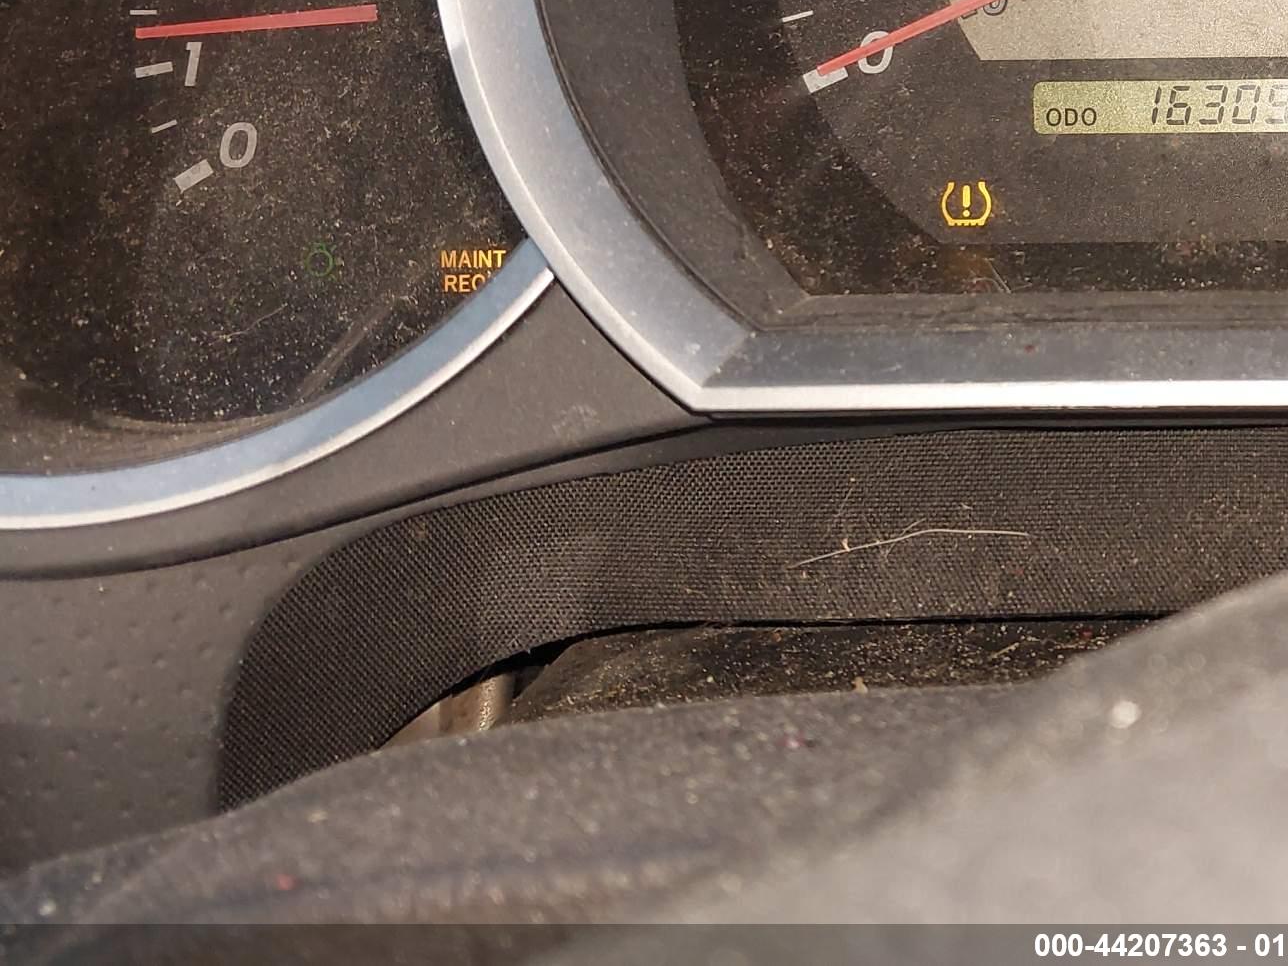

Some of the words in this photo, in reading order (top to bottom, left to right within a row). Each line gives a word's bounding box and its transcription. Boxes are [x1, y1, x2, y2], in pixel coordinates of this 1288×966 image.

[184, 42, 201, 87] 1
[857, 31, 894, 74] 0
[1046, 107, 1098, 127] ODO
[219, 122, 258, 169] 0
[440, 249, 507, 268] MAINT
